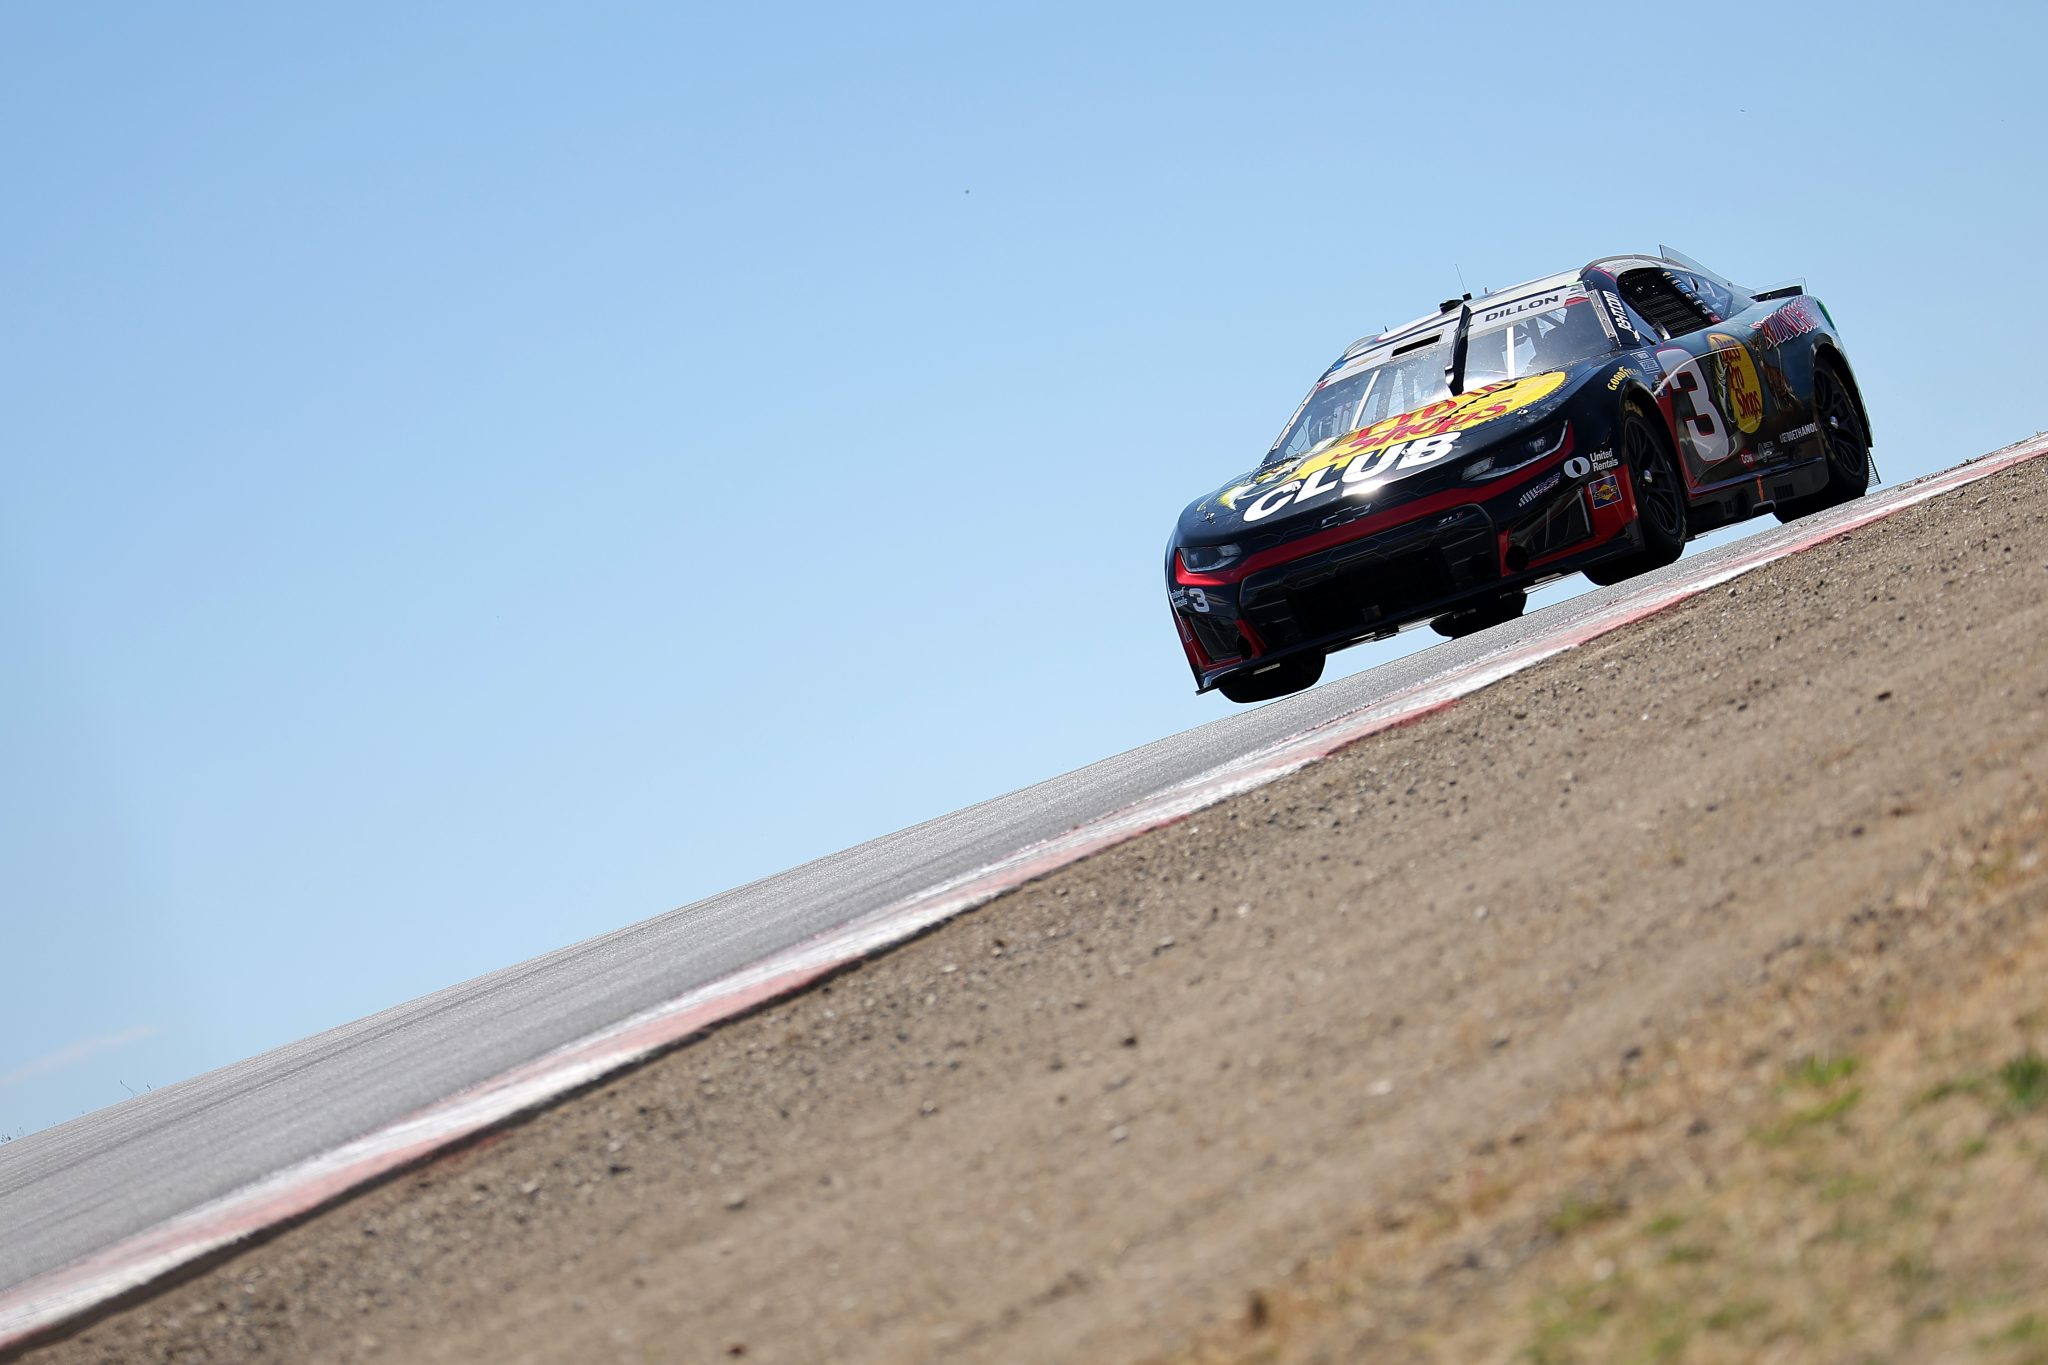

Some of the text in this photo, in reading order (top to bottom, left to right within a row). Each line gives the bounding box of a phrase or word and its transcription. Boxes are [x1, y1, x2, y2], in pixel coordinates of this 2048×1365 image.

[1485, 295, 1559, 322] DILLON
[1727, 362, 1745, 389] Pro
[1657, 349, 1730, 462] 3
[1735, 391, 1761, 422] Shops
[1590, 448, 1613, 462] United
[1592, 457, 1619, 472] Rentals
[1243, 431, 1462, 522] CLUB
[1189, 588, 1209, 612] 3
